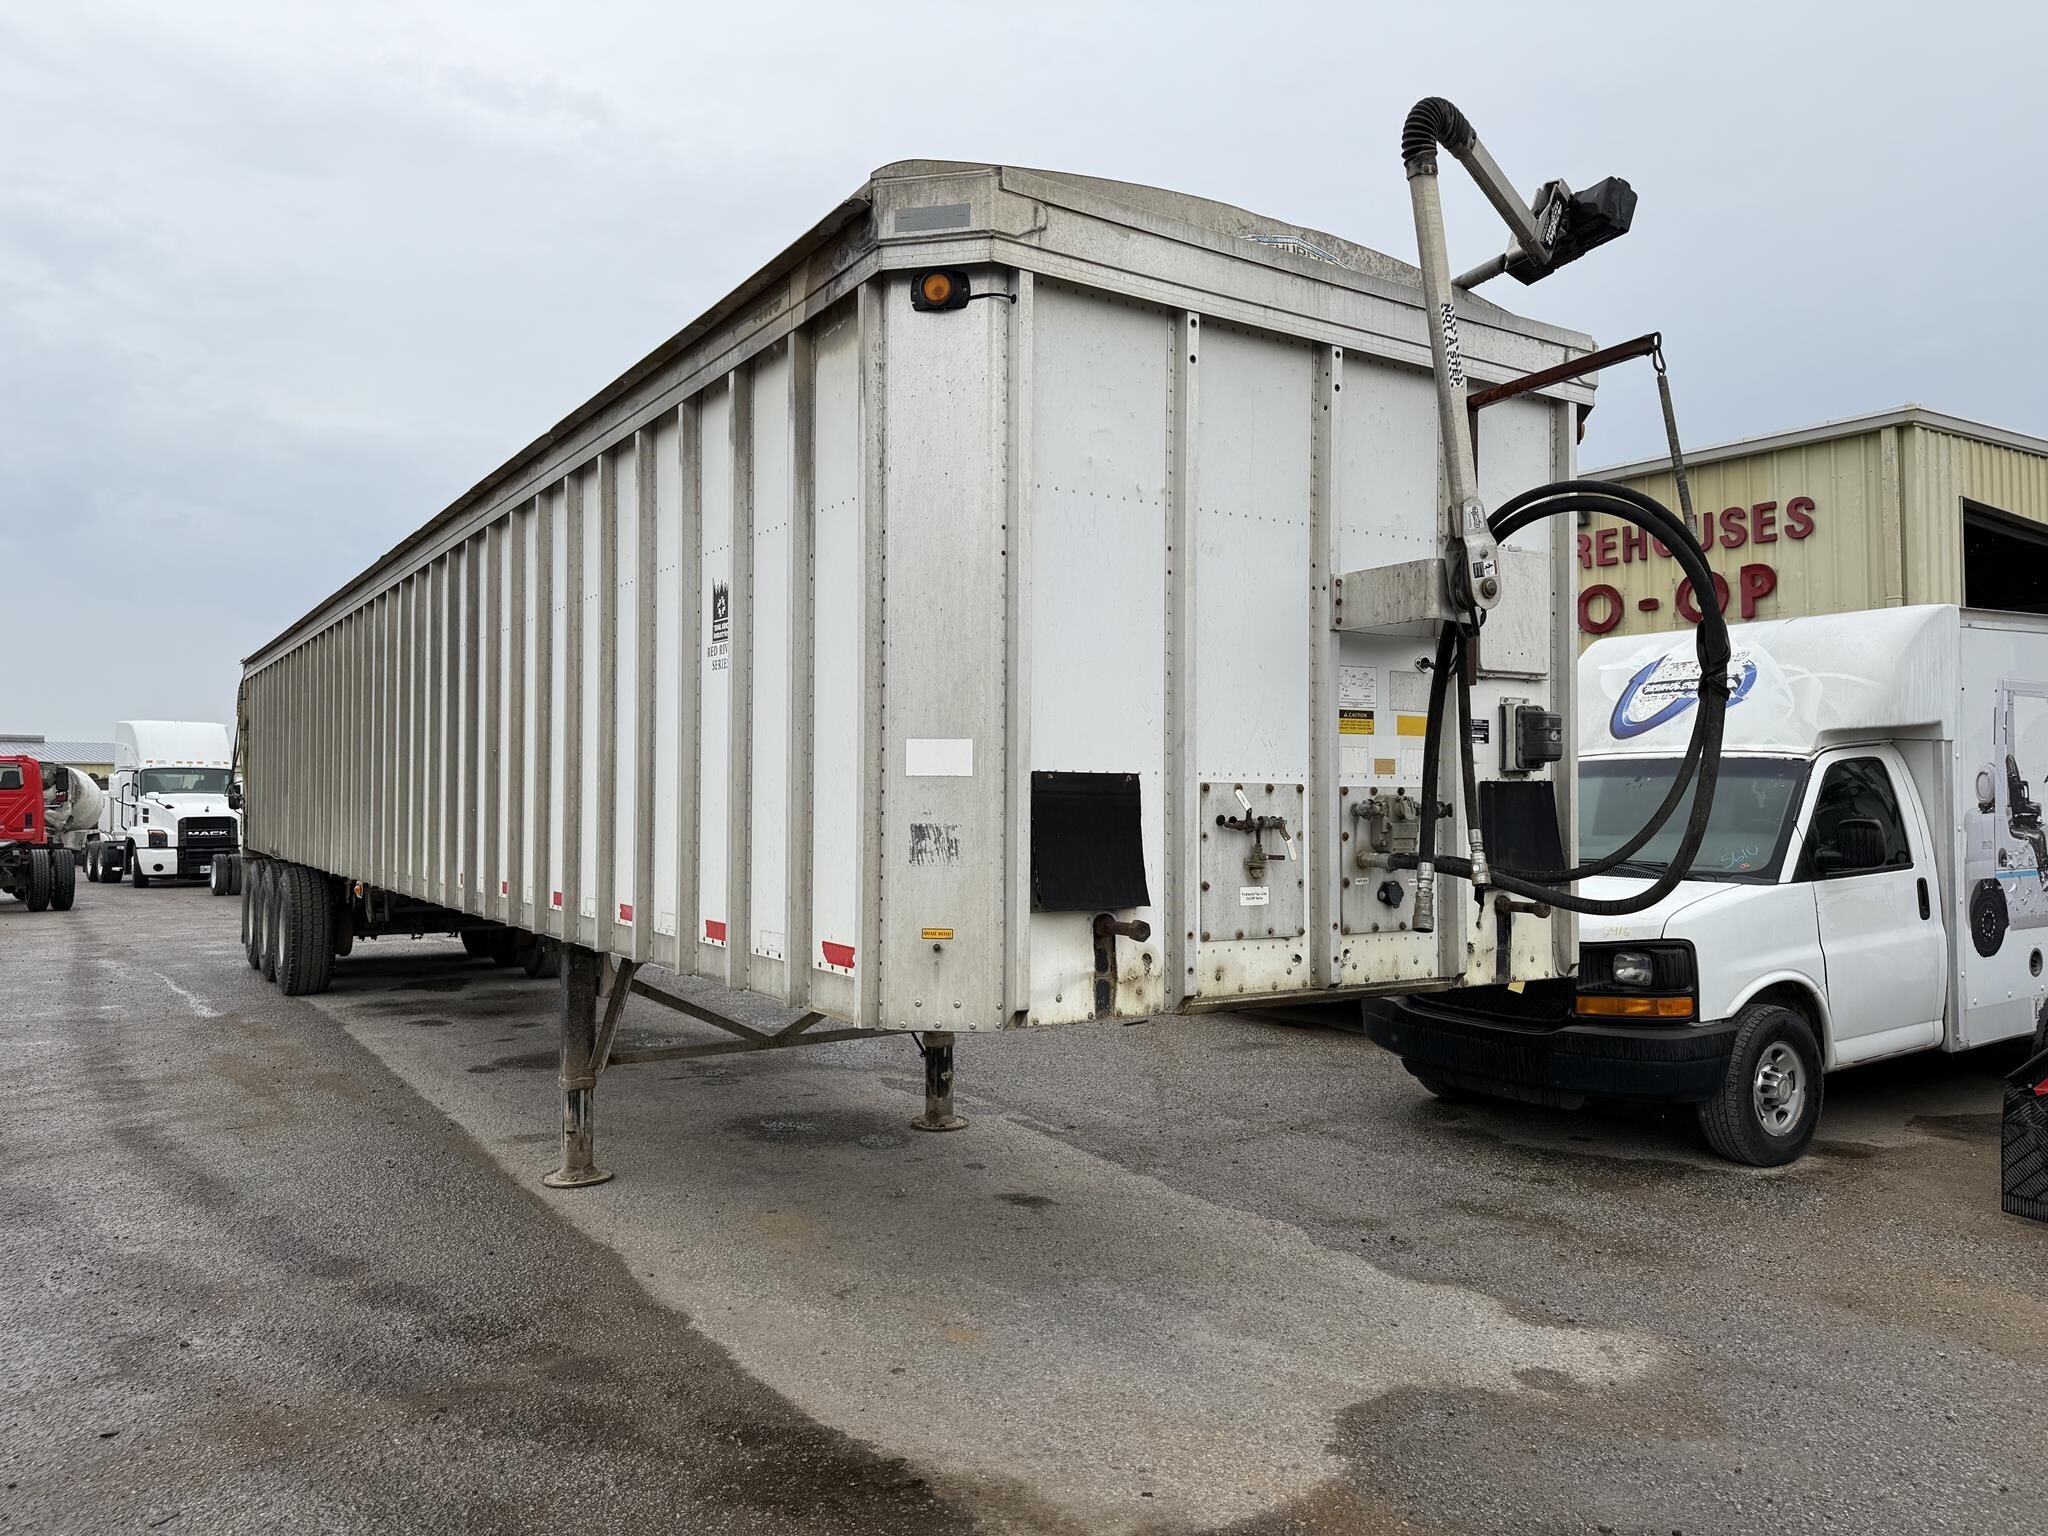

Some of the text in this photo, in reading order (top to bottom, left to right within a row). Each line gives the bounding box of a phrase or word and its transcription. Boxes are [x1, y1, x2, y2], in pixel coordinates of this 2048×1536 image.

[1443, 303, 1461, 386] NOT A STEP
[712, 658, 728, 671] SERIE
